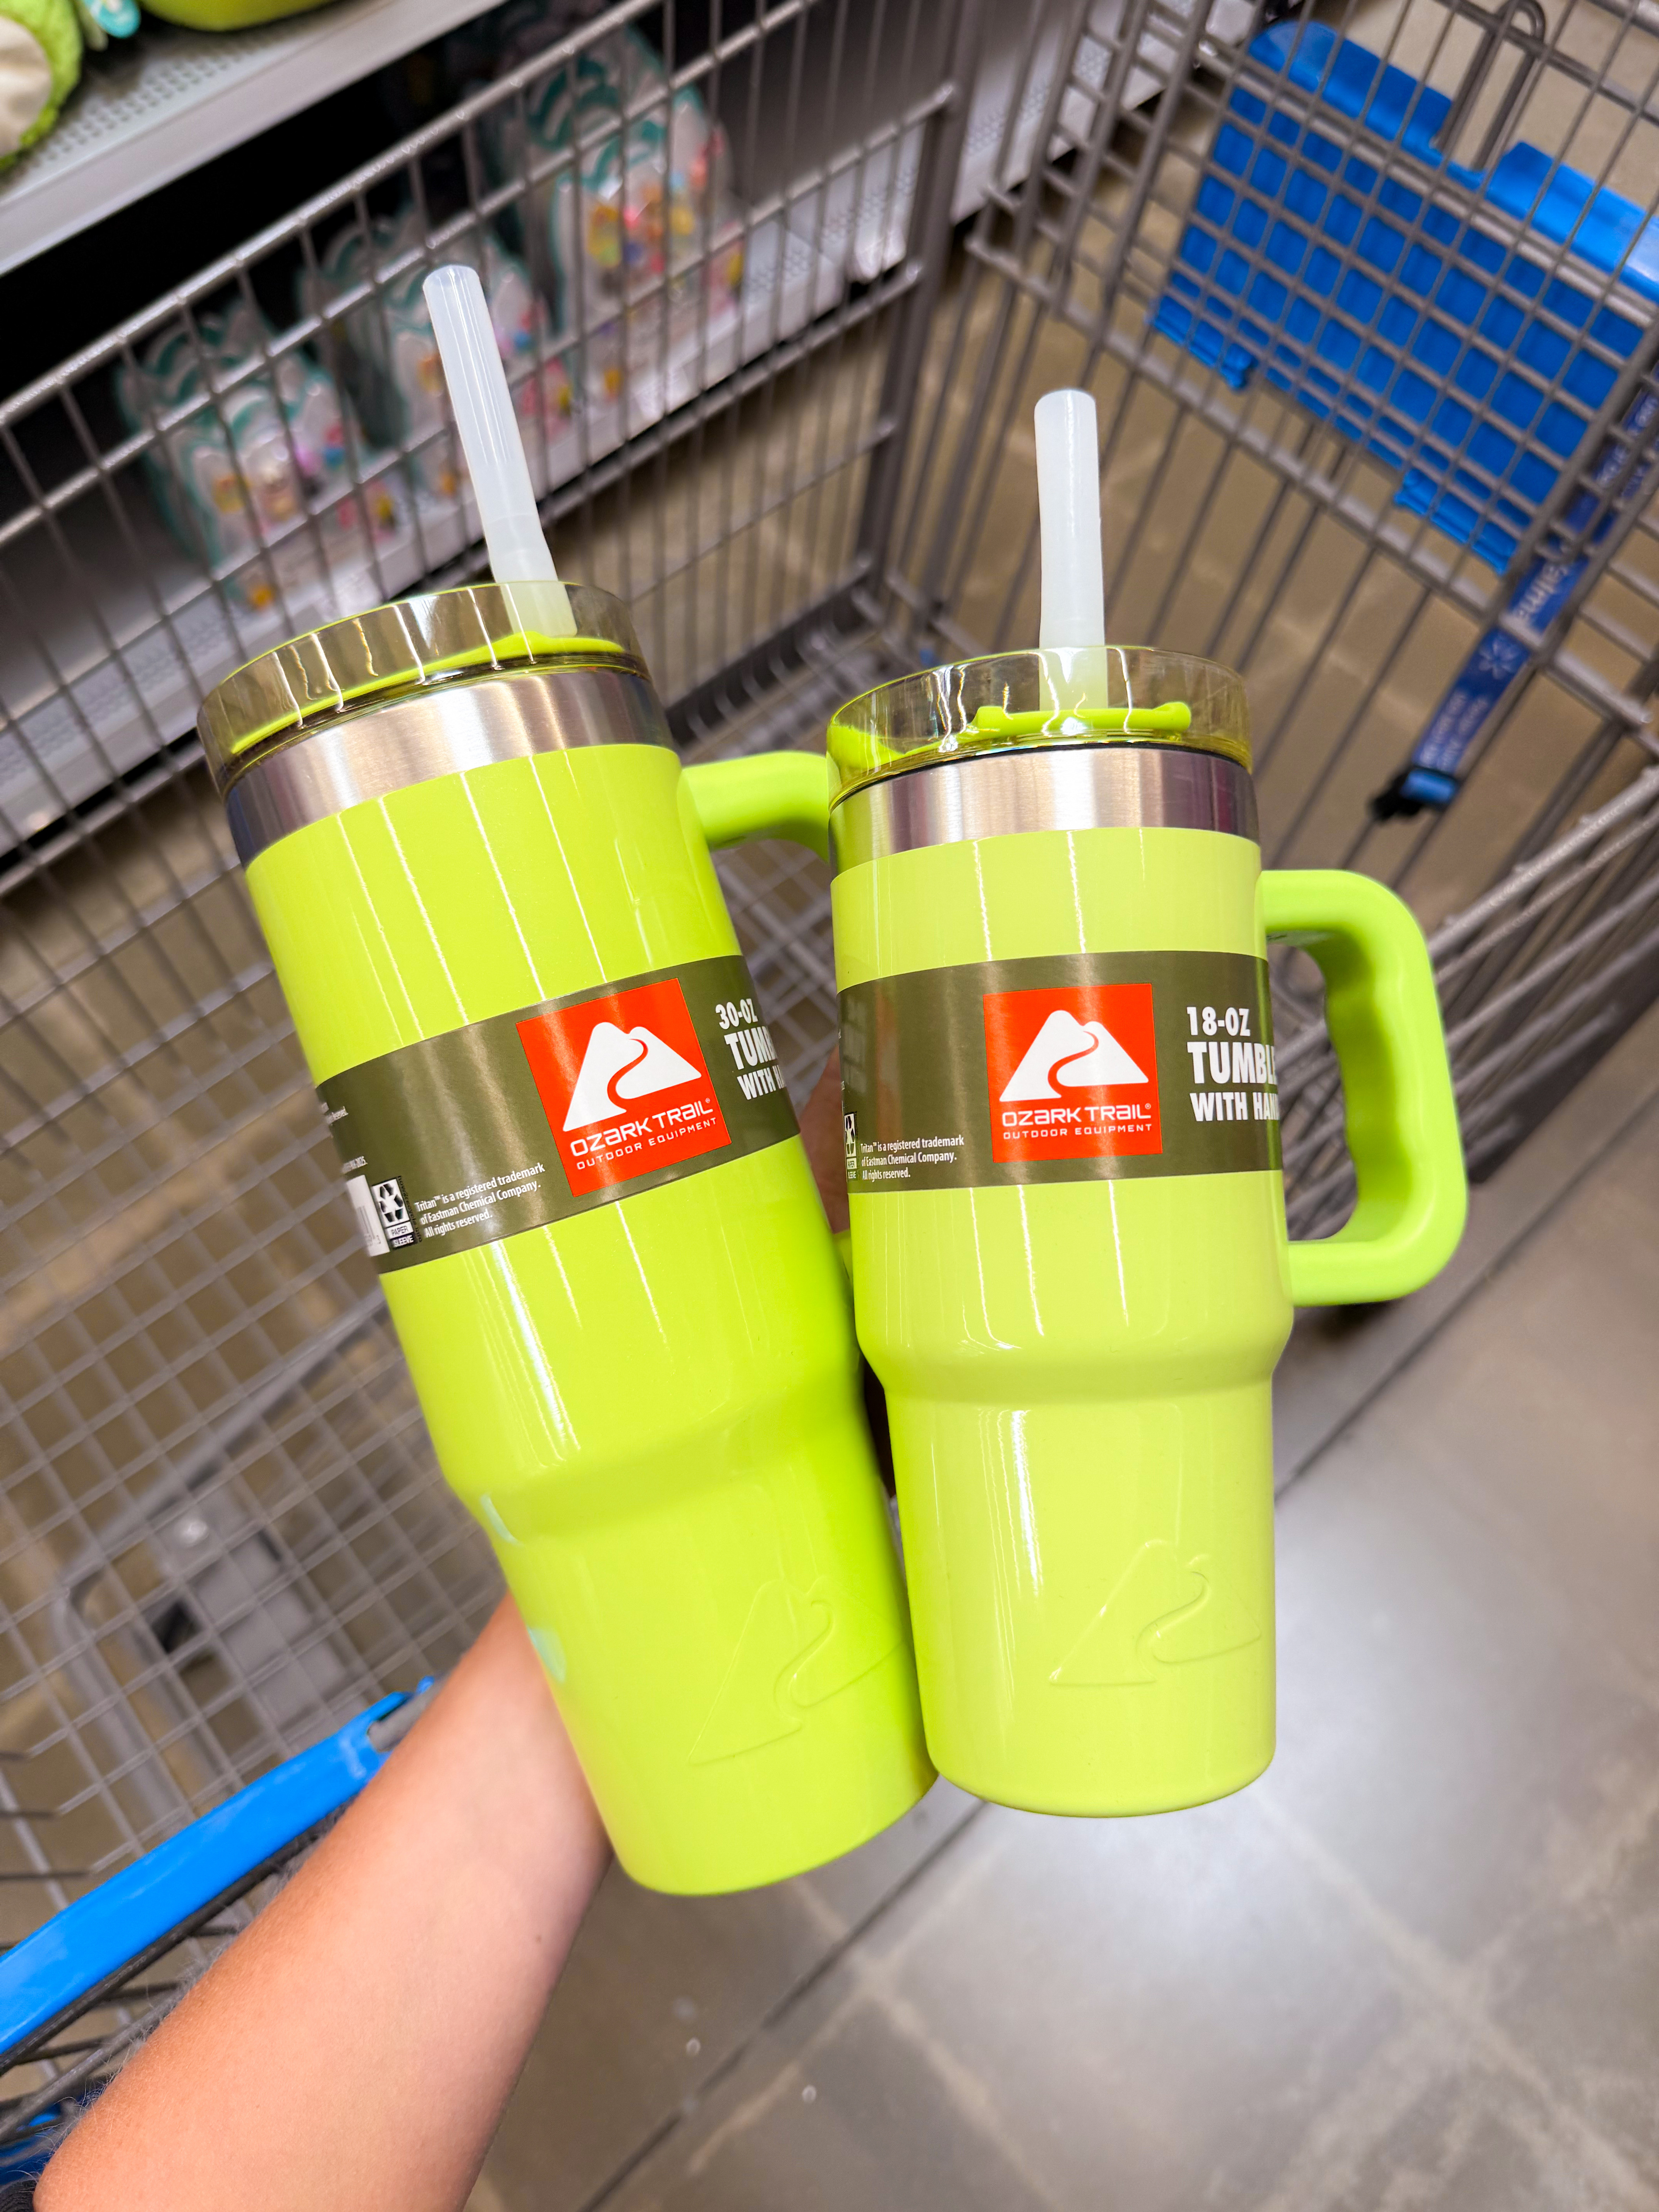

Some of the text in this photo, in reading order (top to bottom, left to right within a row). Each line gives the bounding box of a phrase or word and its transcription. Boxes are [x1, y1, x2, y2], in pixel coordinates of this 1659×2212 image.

[715, 998, 758, 1029] 30-OZ
[1187, 1006, 1250, 1036] 18-OZ
[737, 1067, 776, 1100] WITH
[1002, 1107, 1082, 1127] OZARK
[1190, 1092, 1248, 1121] WITH
[570, 1118, 653, 1156] OZARK
[577, 1117, 716, 1170] OUTDOOR EQUIPMENT
[878, 1142, 882, 1152] is
[887, 1138, 921, 1153] registered
[921, 1134, 964, 1148] trademark
[1003, 1124, 1152, 1139] OUTDOOR EQUIPMENT
[861, 1157, 867, 1167] of
[866, 1156, 887, 1166] Eastman
[888, 1152, 916, 1165] Chemical
[917, 1151, 957, 1164] Company.
[441, 1194, 450, 1204] is
[455, 1177, 498, 1201] registered
[497, 1162, 545, 1186] trademark
[868, 1170, 882, 1182] rights
[883, 1167, 911, 1179] reserved.
[420, 1180, 541, 1225] of Eastman Chemical Company.
[391, 1225, 409, 1237] PAPER
[424, 1209, 493, 1238] All rights reserved.
[393, 1235, 414, 1247] SLEEVE
